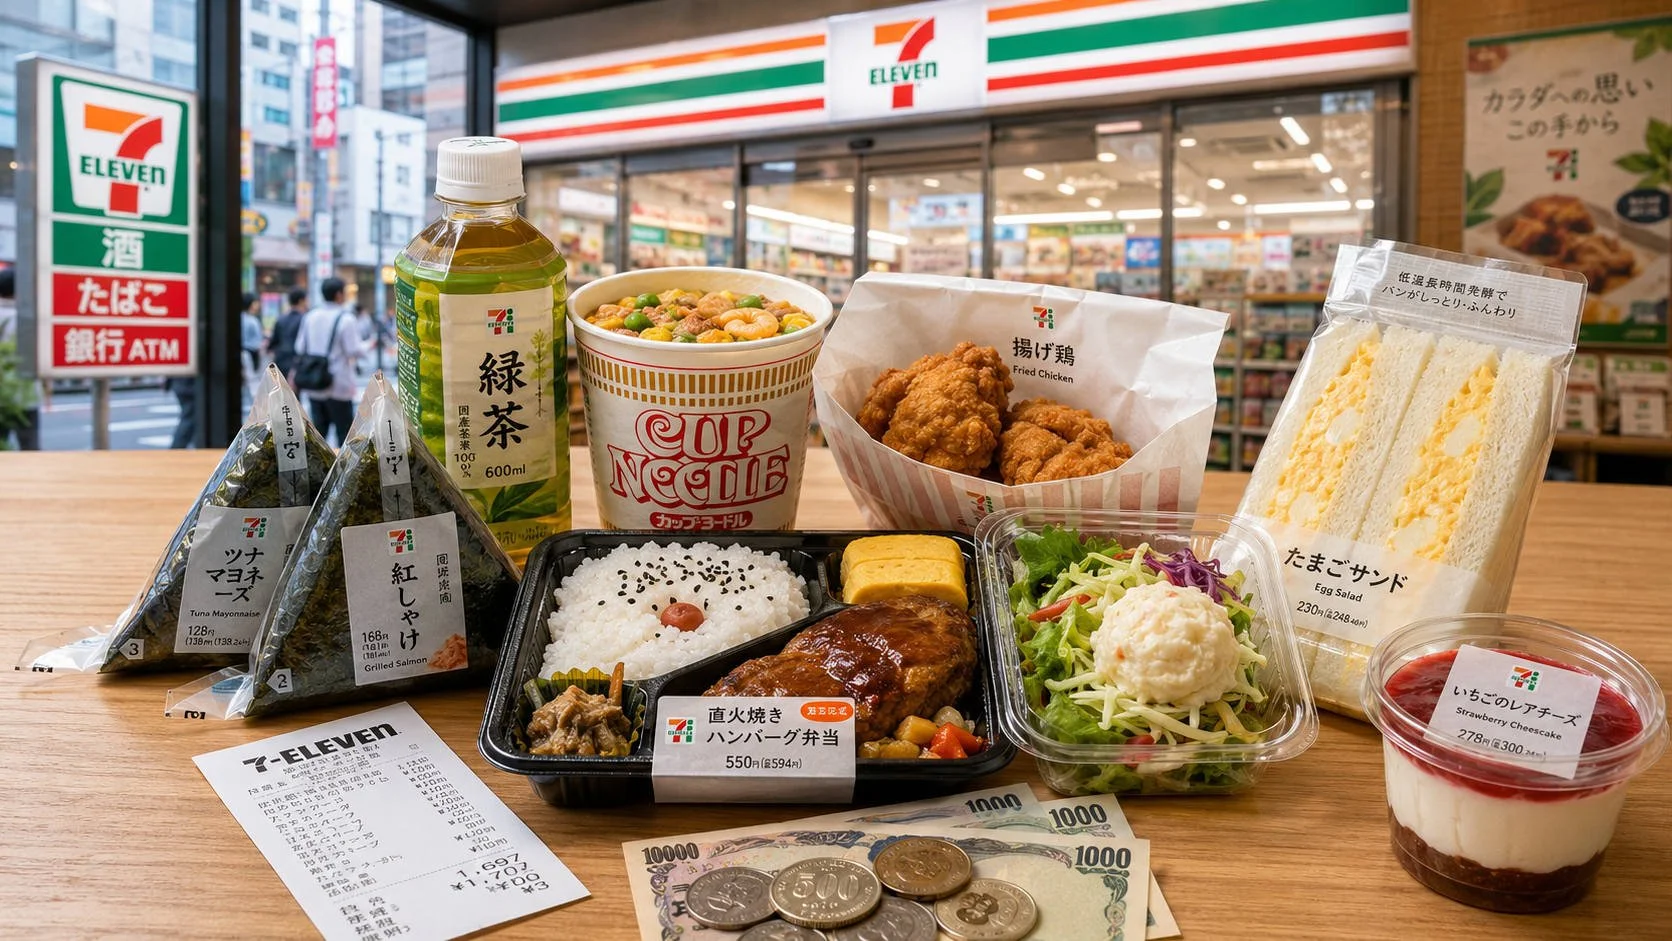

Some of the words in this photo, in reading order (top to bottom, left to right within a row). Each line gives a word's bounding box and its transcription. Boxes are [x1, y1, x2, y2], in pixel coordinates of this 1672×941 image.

[1483, 72, 1654, 114] カラダへの思い
[1507, 111, 1619, 141] この手から
[101, 228, 145, 270] 酒
[78, 277, 168, 316] たばこ
[64, 327, 125, 364] 銀行
[128, 338, 179, 361] ATM
[1012, 337, 1075, 367] 揚げ鶏
[1013, 365, 1036, 377] Fried
[1038, 370, 1074, 384] Chicken
[479, 350, 532, 450] 緑茶
[635, 409, 771, 461] CUP
[485, 464, 526, 478] 600ml
[224, 547, 264, 565] ツナ
[206, 566, 264, 585] マヨネ
[1284, 547, 1408, 593] たまごサンド
[1315, 583, 1333, 596] Egg
[1335, 588, 1363, 602] Salad
[212, 610, 260, 618] Mayonnaise
[391, 562, 420, 651] 紅しゃけ
[129, 643, 139, 656] 3
[364, 661, 394, 672] Grilled
[396, 657, 427, 667] Salmon
[277, 674, 287, 688] 2
[708, 707, 783, 724] 直火焼き
[1454, 686, 1582, 727] いちごのレアチーズ
[1456, 707, 1507, 727] Strawberry
[1510, 721, 1562, 740] Cheesecake
[707, 728, 839, 747] ハンバーグ弁当
[1049, 804, 1107, 828] 1000
[642, 843, 699, 865] 10000
[1075, 846, 1131, 868] 1000
[792, 873, 860, 900] 500
